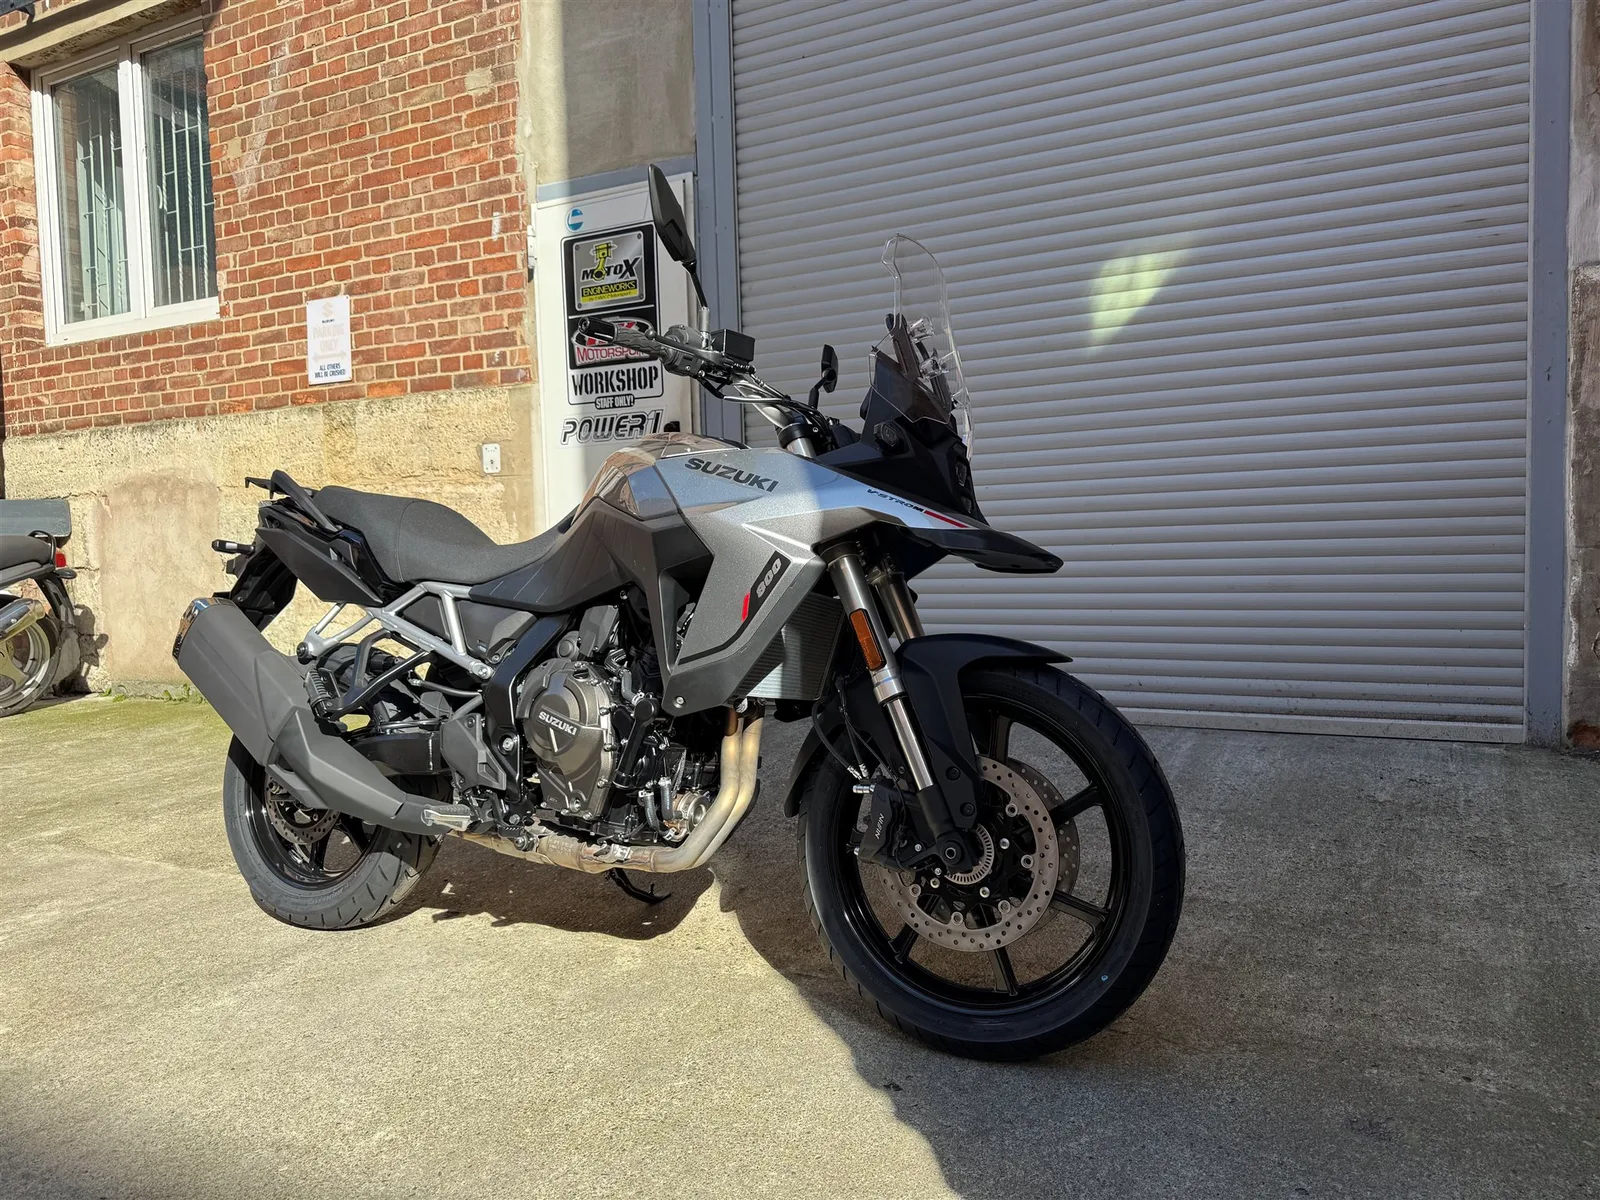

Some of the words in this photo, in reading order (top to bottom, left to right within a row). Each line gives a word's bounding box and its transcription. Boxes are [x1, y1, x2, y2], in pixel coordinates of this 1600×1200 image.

[583, 281, 636, 296] ENGINEWORKS
[313, 323, 345, 338] PARKING
[320, 339, 338, 353] ONLY
[576, 346, 646, 361] MOTORSPO
[329, 369, 346, 377] CRUSHED
[572, 366, 659, 396] WORKSHOP
[596, 397, 614, 409] STAFF
[614, 395, 634, 407] ONLY!
[684, 458, 779, 492] SUZUKI
[756, 557, 782, 598] 800
[538, 711, 577, 736] SUZUKI
